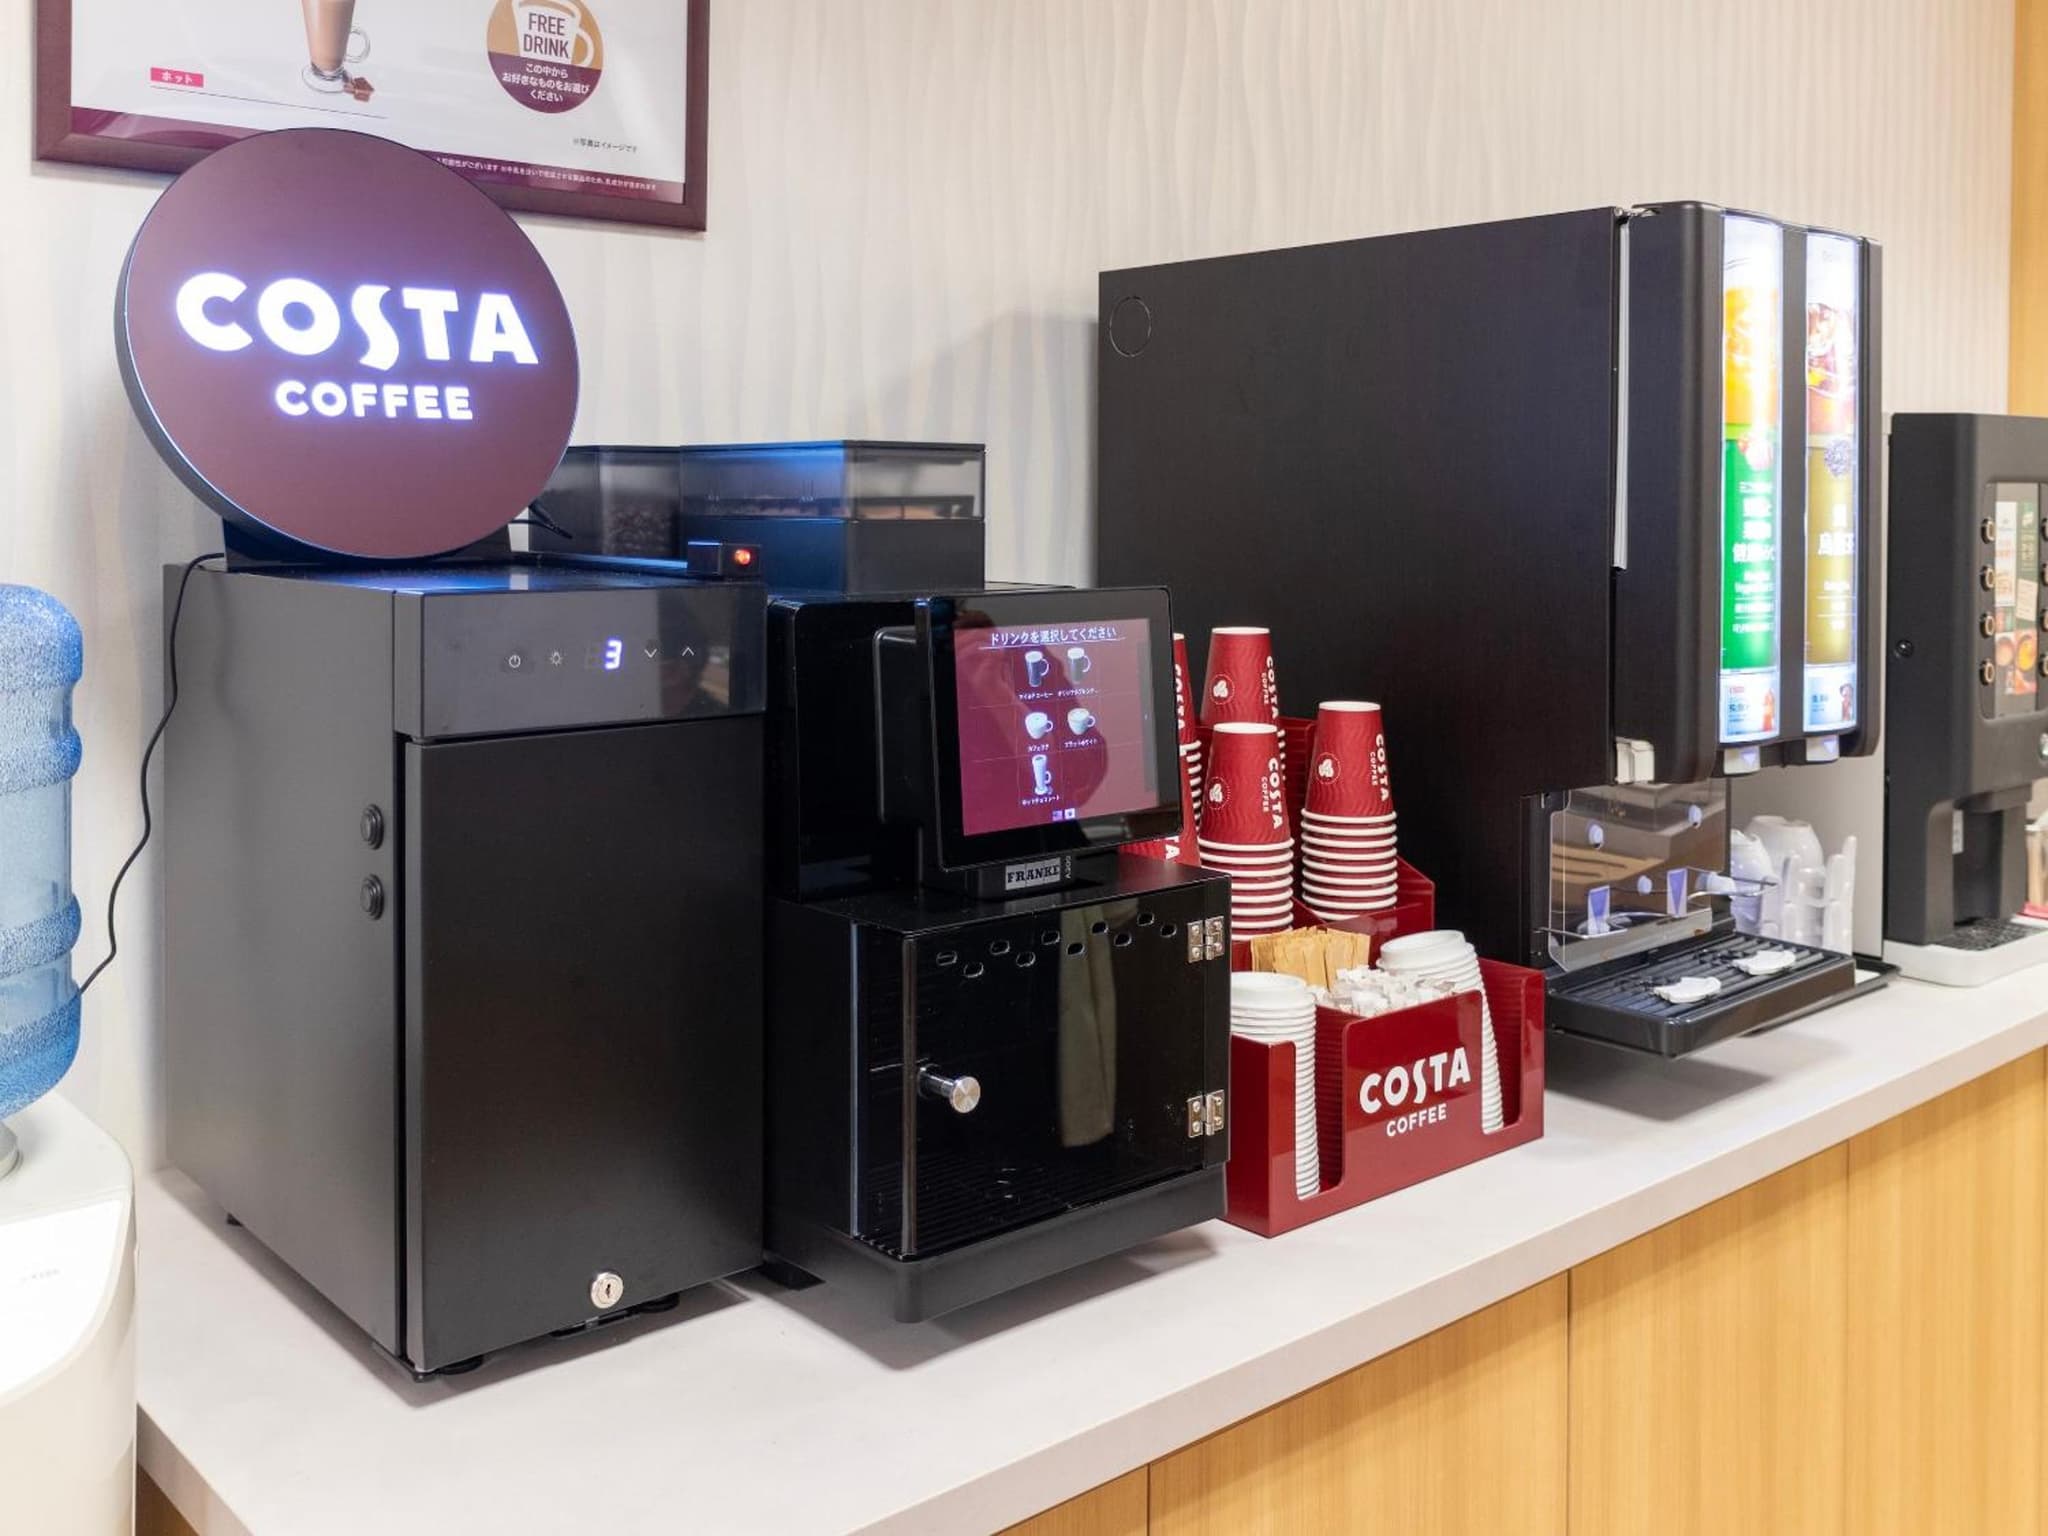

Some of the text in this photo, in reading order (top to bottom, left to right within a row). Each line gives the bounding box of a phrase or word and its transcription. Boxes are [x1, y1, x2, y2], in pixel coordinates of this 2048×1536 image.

[528, 13, 566, 36] FREE
[523, 34, 570, 59] DRINK
[161, 71, 193, 84] ホット
[502, 72, 591, 95] お好きなものをお選び
[525, 63, 569, 79] この中から
[530, 89, 564, 102] ください
[175, 271, 540, 371] COSTA
[273, 379, 474, 421] COFFEE
[991, 627, 1117, 646] ドリンクを選択してください
[604, 639, 624, 670] 3
[1260, 672, 1270, 705] COFFEE
[1266, 655, 1280, 720] COSTA
[1369, 751, 1378, 786] COFFEE
[1375, 733, 1390, 802] COSTA
[1260, 776, 1270, 813] COFFEE
[1268, 757, 1284, 830] COSTA
[1359, 1046, 1472, 1115] COSTA
[1385, 1102, 1448, 1138] COFFEE
